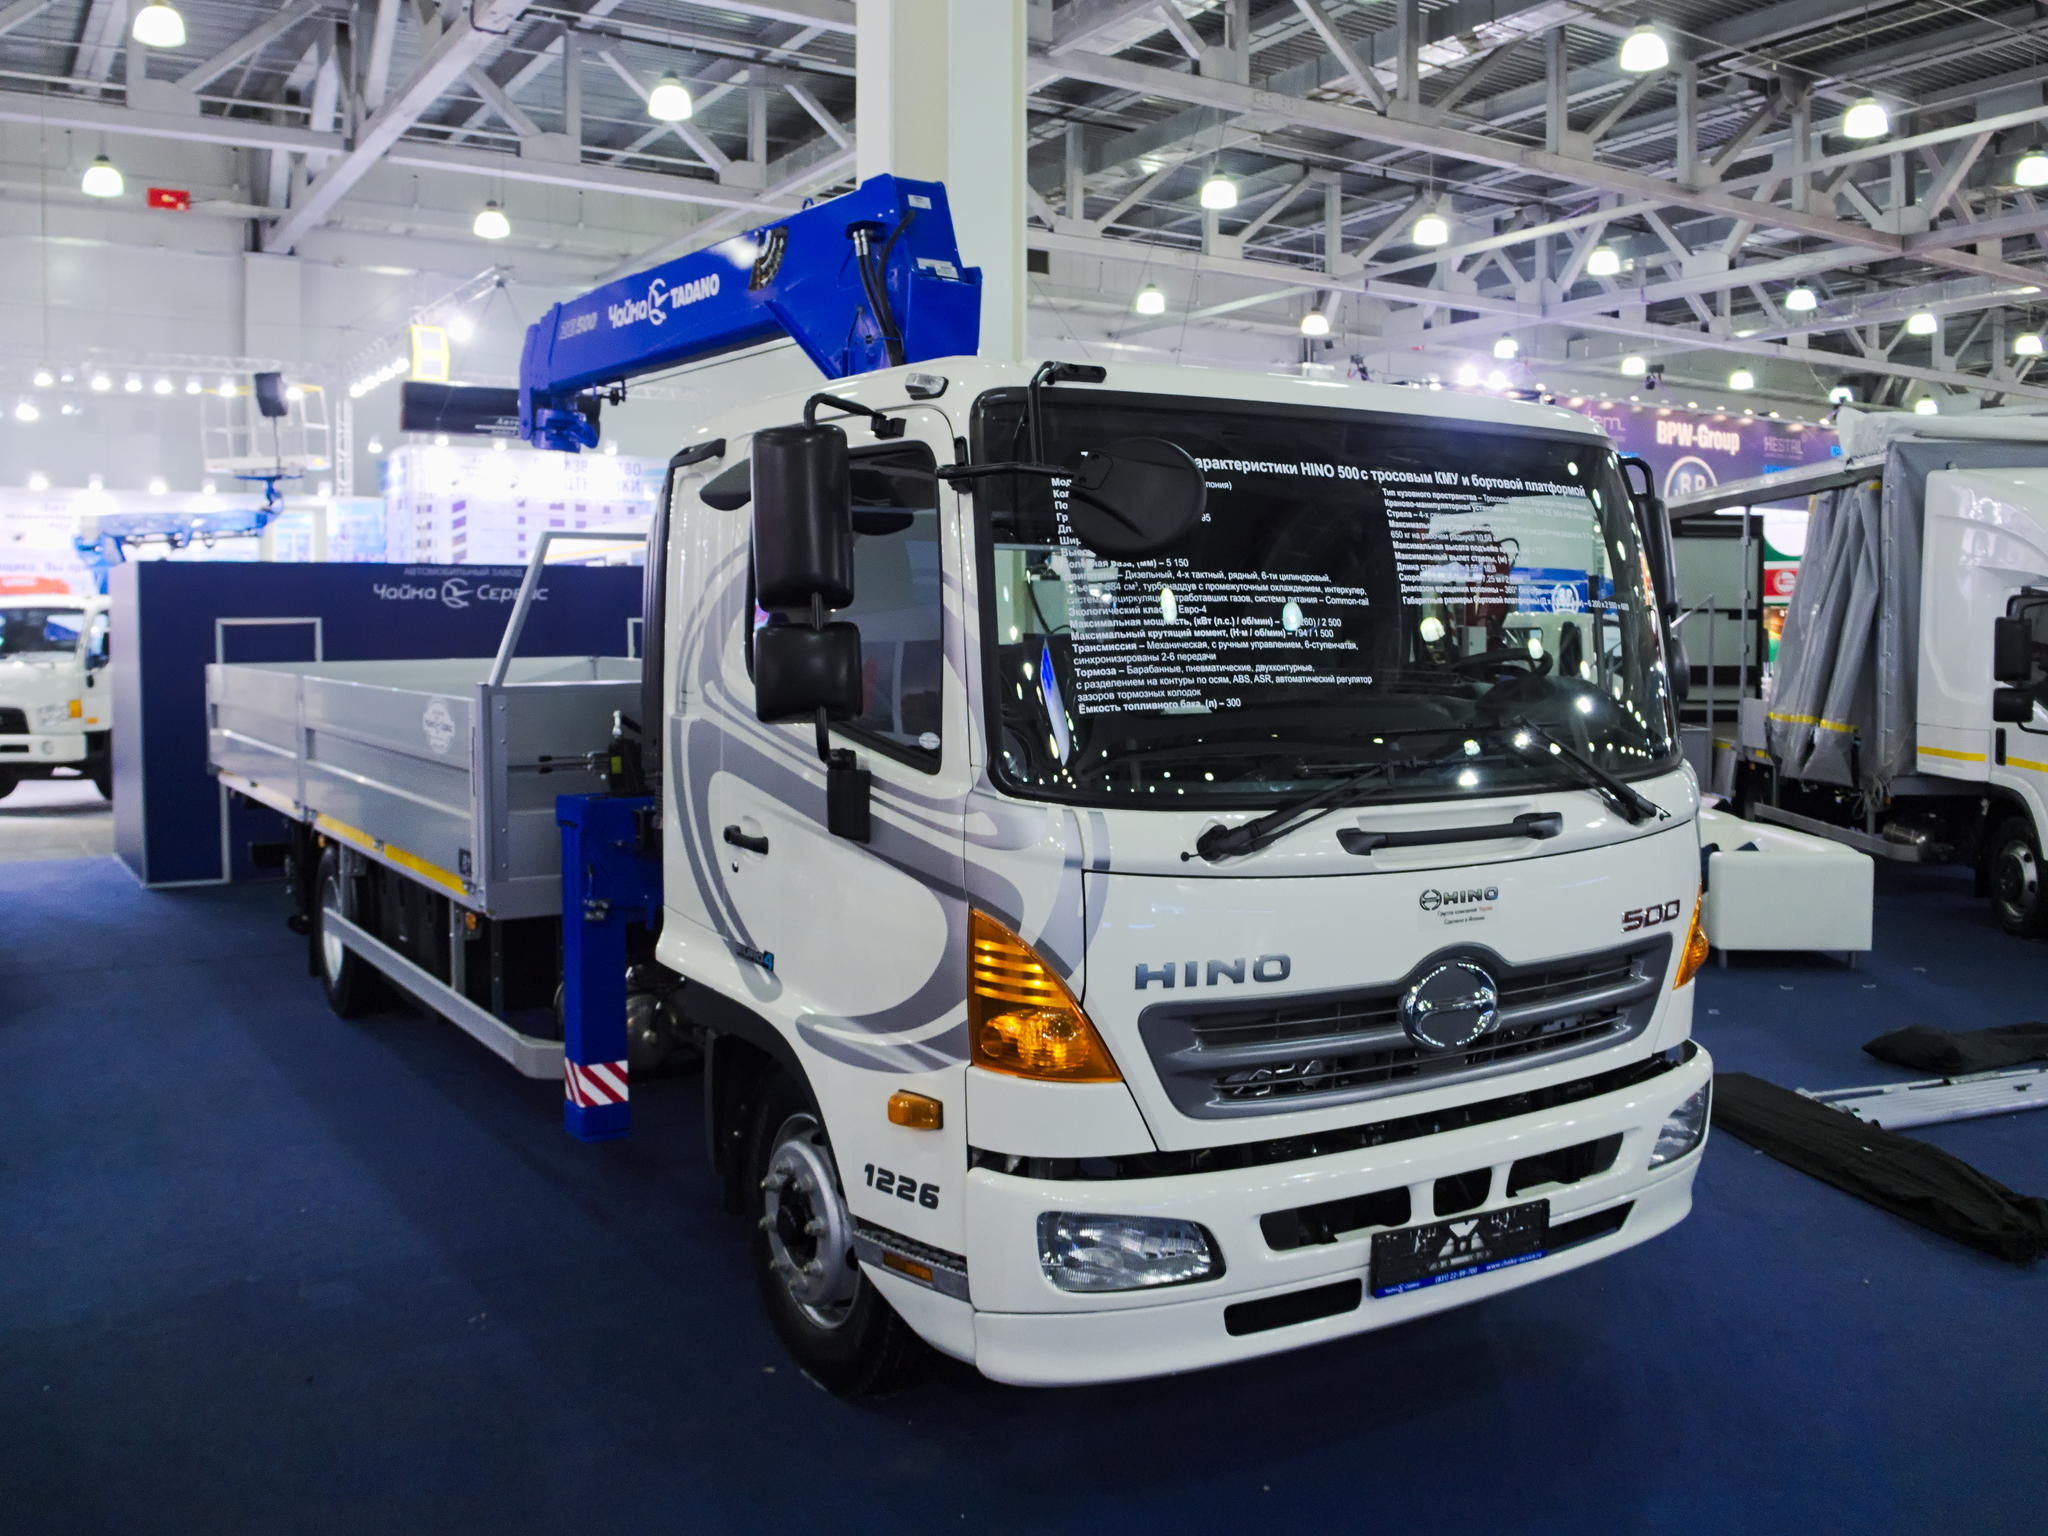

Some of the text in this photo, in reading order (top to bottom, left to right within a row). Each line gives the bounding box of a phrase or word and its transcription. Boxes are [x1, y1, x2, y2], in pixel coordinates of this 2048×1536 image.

[670, 273, 720, 309] TADANO
[1656, 420, 1740, 456] BPW-Group
[1195, 457, 1586, 498] арактеристики HINO 500 с тросовым КМУ и бортовой платформой
[1205, 480, 1232, 490] пония)
[1382, 487, 1396, 497] Тип
[1397, 490, 1431, 499] кузовного
[1432, 492, 1477, 501] пространства
[1386, 509, 1413, 519] Стрела
[1390, 530, 1403, 539] 650
[1392, 541, 1444, 551] Максимальная
[1445, 544, 1470, 552] высота
[1166, 559, 1172, 567] 5
[1173, 558, 1189, 567] 150
[1394, 551, 1448, 562] Максимальный
[1396, 562, 1420, 572] Длина
[1124, 569, 1175, 580] Дизельный,
[1176, 570, 1190, 579] 4-х
[1191, 571, 1227, 580] тактный,
[1228, 572, 1260, 582] рядный,
[1261, 571, 1278, 580] 6-ти
[1279, 573, 1331, 583] цилиндровый,
[373, 584, 549, 603] Чайка Серс
[1143, 583, 1197, 593] турбонаддув
[1205, 584, 1269, 594] промежуточным
[1270, 585, 1323, 595] охлаждением,
[1324, 587, 1368, 597] интеркулер,
[1400, 584, 1434, 594] Диапазон
[1435, 586, 1469, 595] вращения
[1470, 586, 1499, 594] колонны
[1229, 595, 1253, 604] газов,
[1254, 596, 1286, 604] система
[1287, 596, 1318, 604] питания
[1325, 596, 1369, 606] Common-rail
[1402, 596, 1443, 607] Габаритные
[1443, 597, 1473, 606] размеры
[1068, 605, 1207, 617] Экологический клас Евро-4
[1070, 618, 1141, 629] Максимальная
[1193, 617, 1211, 627] (кВт
[1241, 617, 1274, 627] об/мин)
[1328, 618, 1342, 627] 500
[1071, 630, 1146, 642] Максимальный
[1147, 630, 1192, 640] крутящий
[1194, 629, 1229, 639] момент,
[1255, 629, 1286, 639] об/мин)
[1320, 629, 1334, 638] 500
[1072, 643, 1137, 655] Трансмиссия
[1146, 641, 1210, 651] Механическая,
[1218, 641, 1249, 650] ручным
[1251, 641, 1303, 651] управлением,
[1304, 640, 1359, 651] 6-ступенчатая,
[1073, 652, 1217, 665] синхронизированы 2-6 передачи
[1074, 663, 1315, 678] Тормоза Барабанные, пневматические, двухконтурные,
[1084, 680, 1145, 691] разделением
[1147, 679, 1158, 687] на
[1159, 677, 1195, 688] контуры
[1197, 677, 1207, 685] по
[1208, 676, 1231, 686] осям,
[1232, 674, 1252, 685] ABS,
[1253, 674, 1274, 684] ASR,
[1275, 675, 1335, 684] автоматический
[1336, 676, 1373, 686] регулятор
[1077, 688, 1202, 702] зазоров тормозных колодок
[1078, 702, 1121, 714] Ёмкость
[1123, 700, 1179, 712] топливного
[1180, 698, 1203, 710] бака,
[1226, 698, 1241, 708] 300
[1443, 886, 1499, 905] HINO
[1621, 897, 1680, 933] 500
[1134, 953, 1291, 990] HINO
[864, 1163, 940, 1210] 1226
